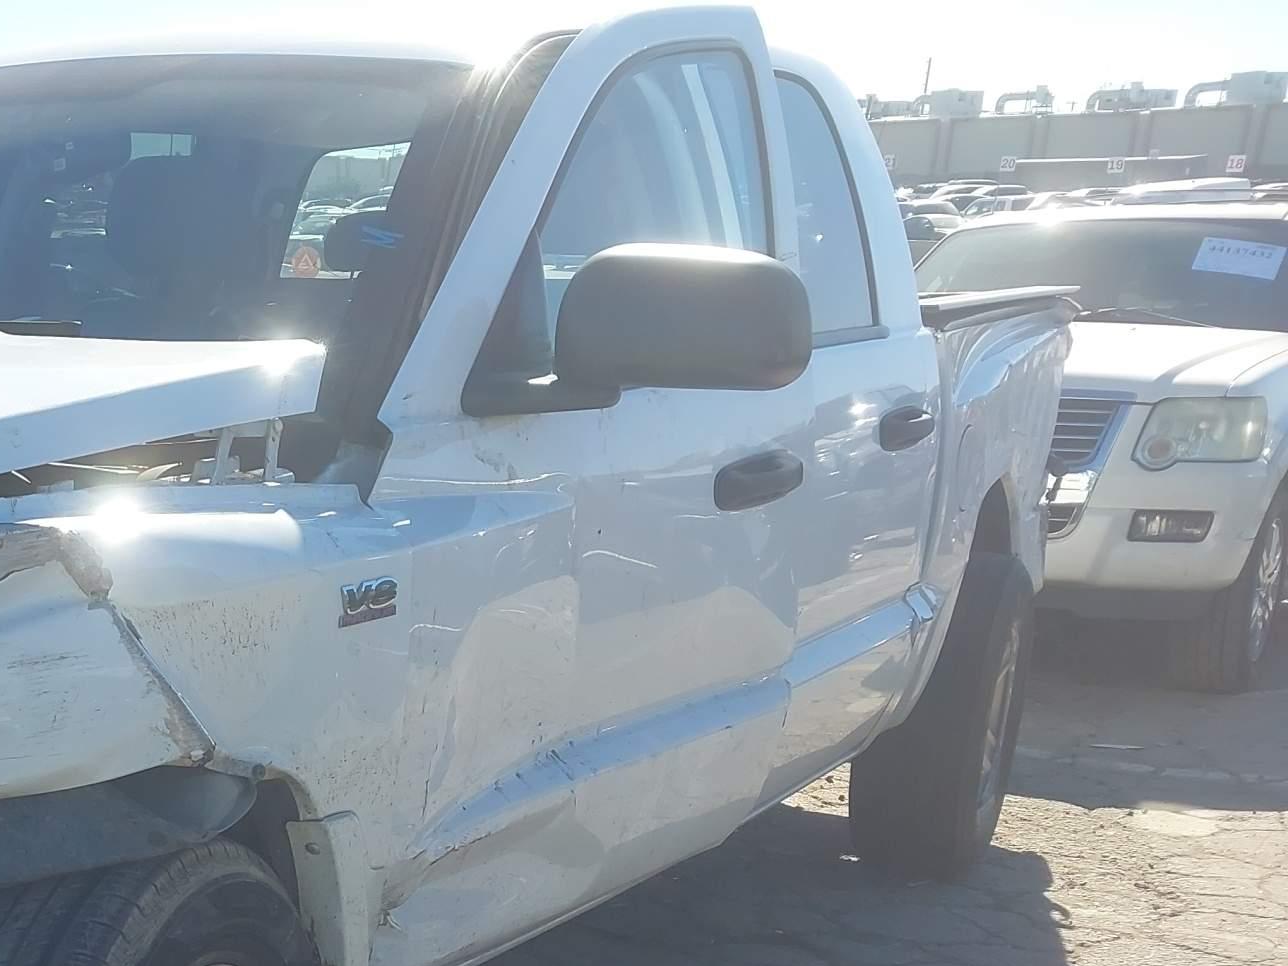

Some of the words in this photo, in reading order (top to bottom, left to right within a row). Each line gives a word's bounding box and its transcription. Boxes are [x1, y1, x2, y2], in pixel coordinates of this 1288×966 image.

[1000, 158, 1016, 169] 20
[1108, 159, 1123, 170] 19
[1229, 158, 1245, 169] 18
